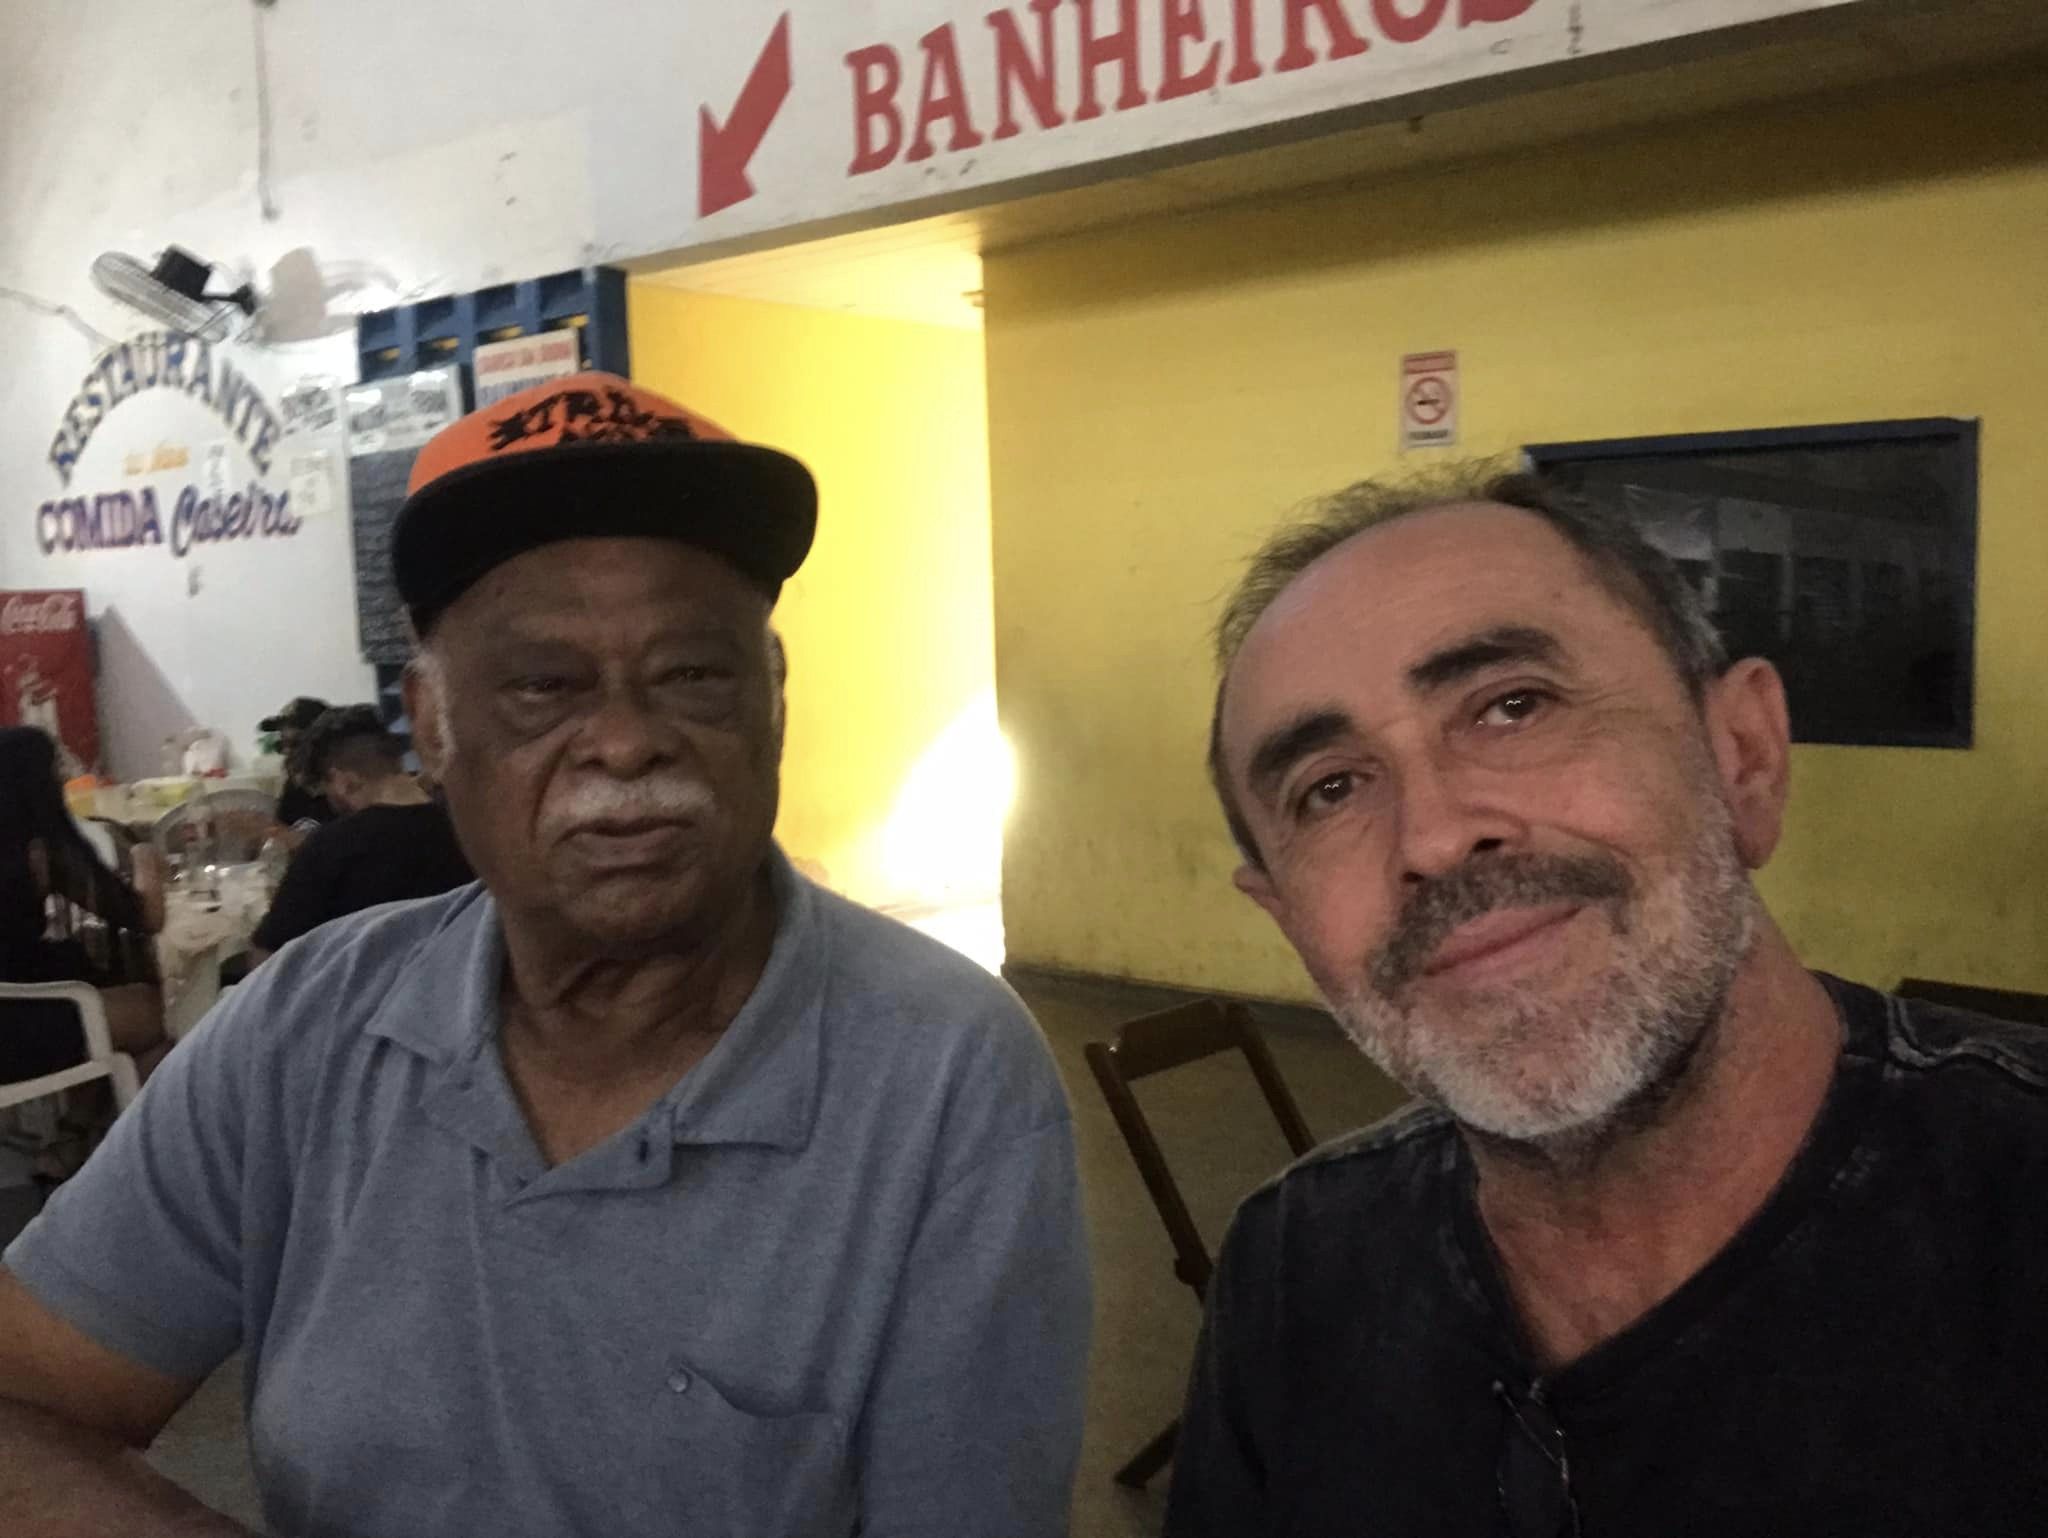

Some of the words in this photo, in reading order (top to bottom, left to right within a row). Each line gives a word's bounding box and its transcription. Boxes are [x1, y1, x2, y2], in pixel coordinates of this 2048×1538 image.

[844, 0, 1533, 177] BANHEI
[48, 330, 282, 489] RESTAURANTE
[37, 485, 163, 554] COMIDA
